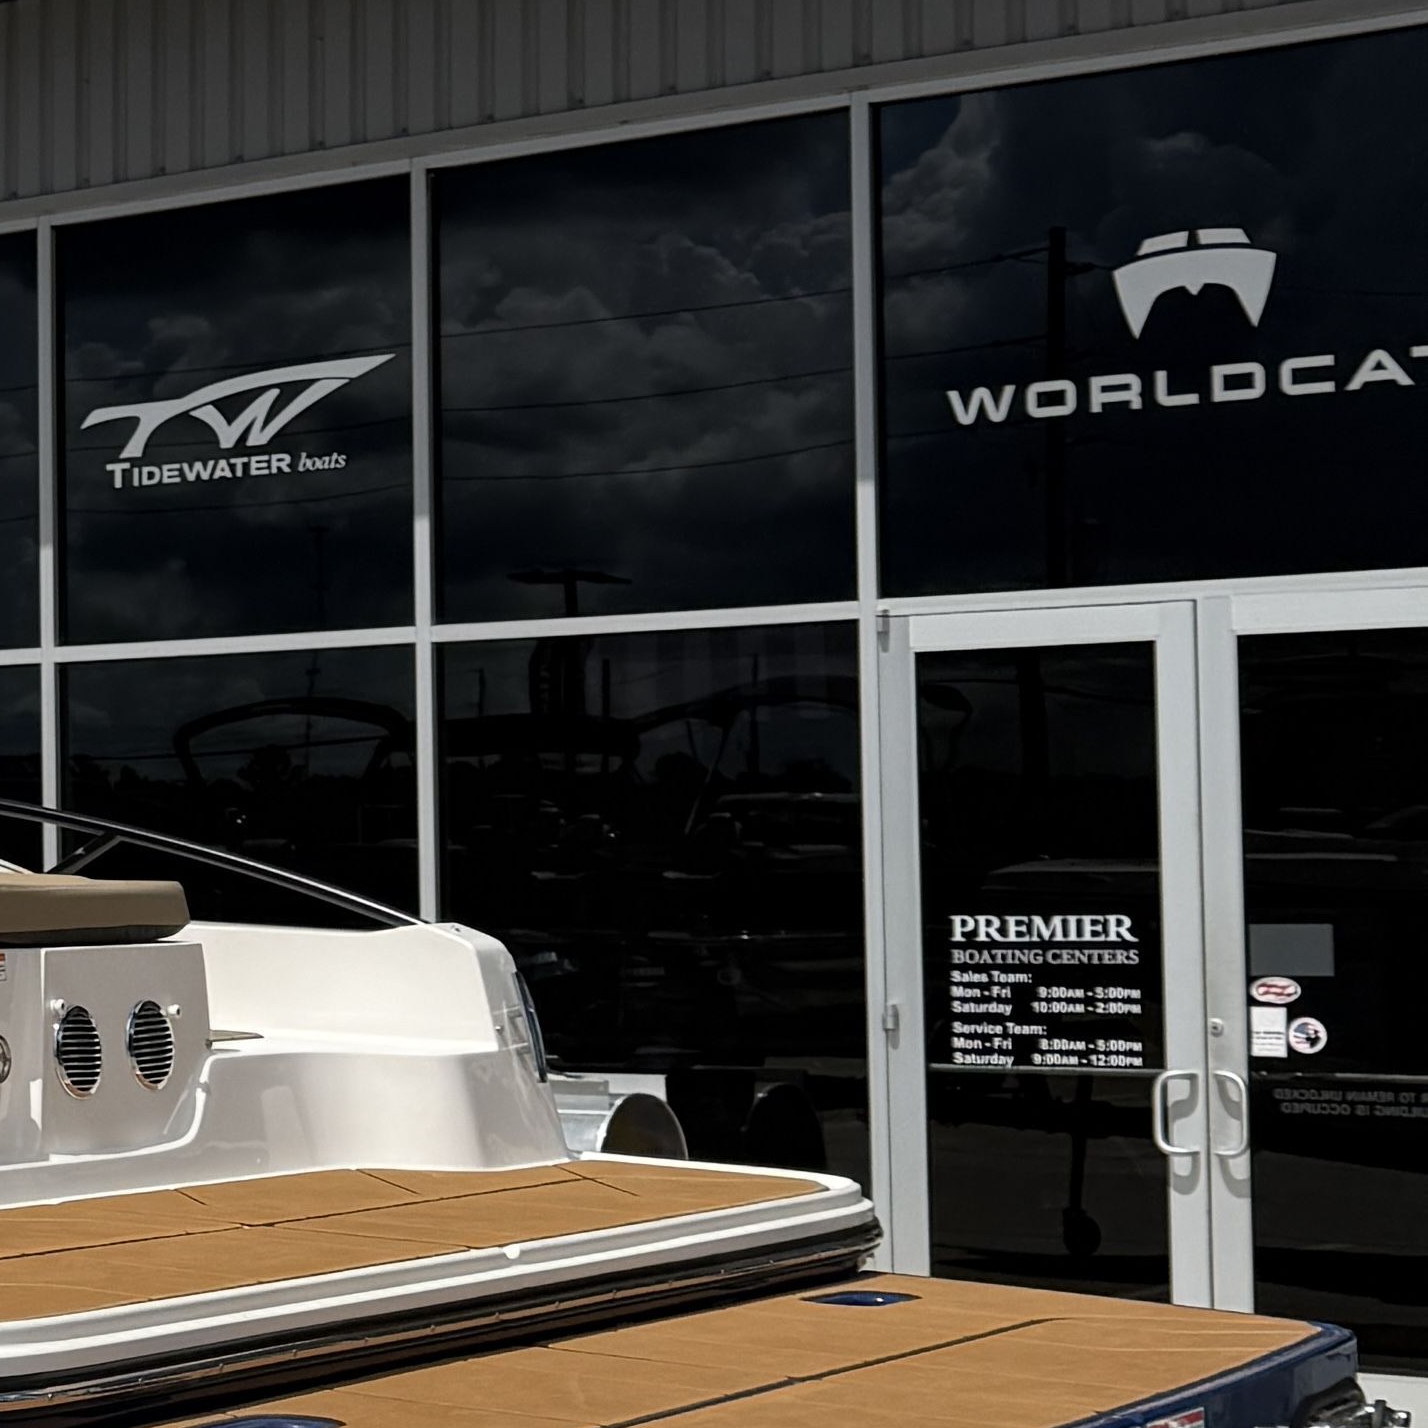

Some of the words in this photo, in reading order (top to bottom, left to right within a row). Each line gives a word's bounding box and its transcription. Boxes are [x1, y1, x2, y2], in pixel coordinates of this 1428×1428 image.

[946, 345, 1428, 426] WORLDCA
[106, 453, 292, 489] TIDEWATER
[298, 452, 347, 472] boats
[948, 914, 1140, 943] PREMIER
[950, 949, 1043, 965] BOATING
[1045, 949, 1140, 965] CENTERS
[950, 970, 989, 983] Sales
[990, 970, 1033, 983] Team:
[950, 986, 981, 998] Mon
[990, 986, 1012, 998] Fri
[951, 1001, 1013, 1016] Saturday
[952, 1021, 1003, 1034] Service
[1004, 1022, 1048, 1035] Team:
[951, 1037, 982, 1049] Mon
[992, 1037, 1013, 1050] Fri
[952, 1052, 1014, 1068] Saturday
